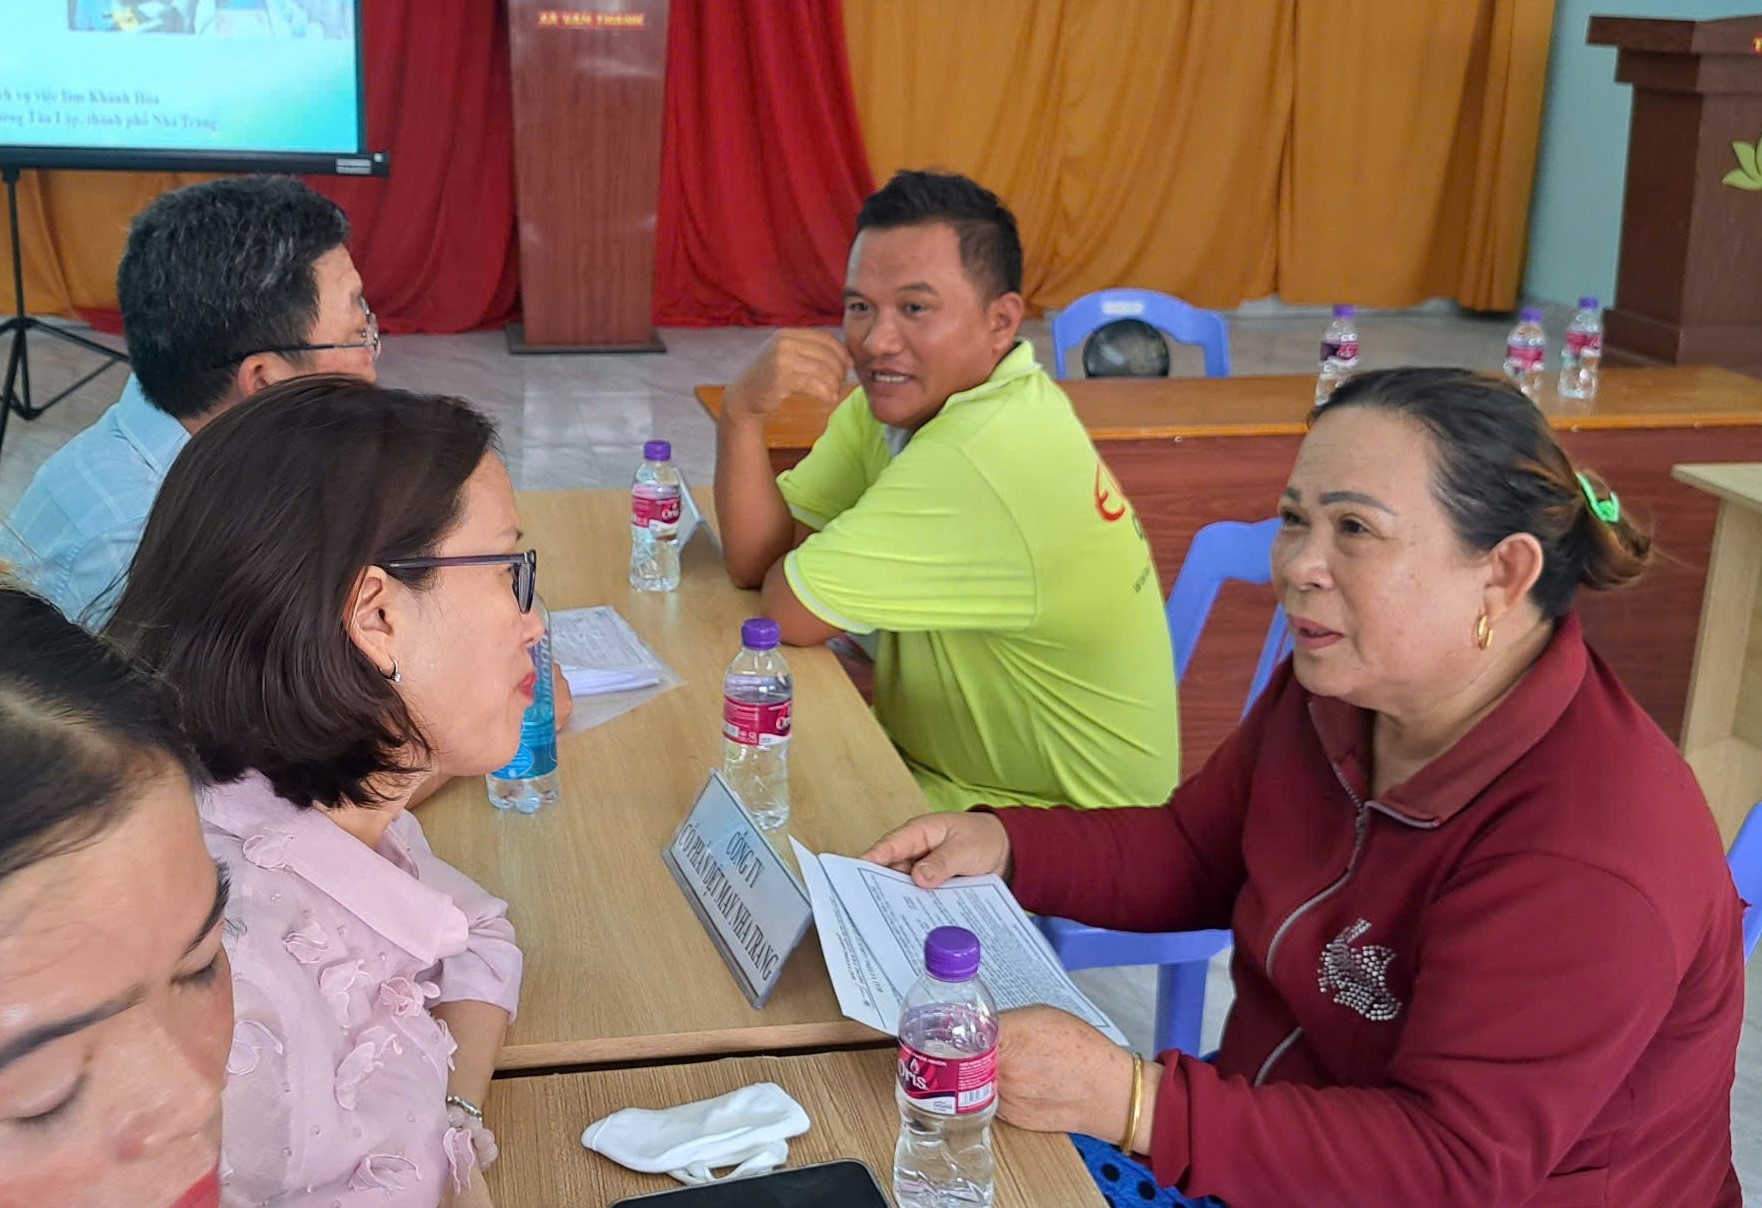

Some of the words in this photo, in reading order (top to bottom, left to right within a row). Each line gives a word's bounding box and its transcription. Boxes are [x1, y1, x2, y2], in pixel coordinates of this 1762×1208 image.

[687, 836, 713, 874] PHẦN
[703, 861, 725, 896] DỆT
[714, 880, 740, 919] MAY
[729, 902, 752, 944] NHA
[745, 925, 778, 980] TRANG
[745, 857, 764, 888] TY
